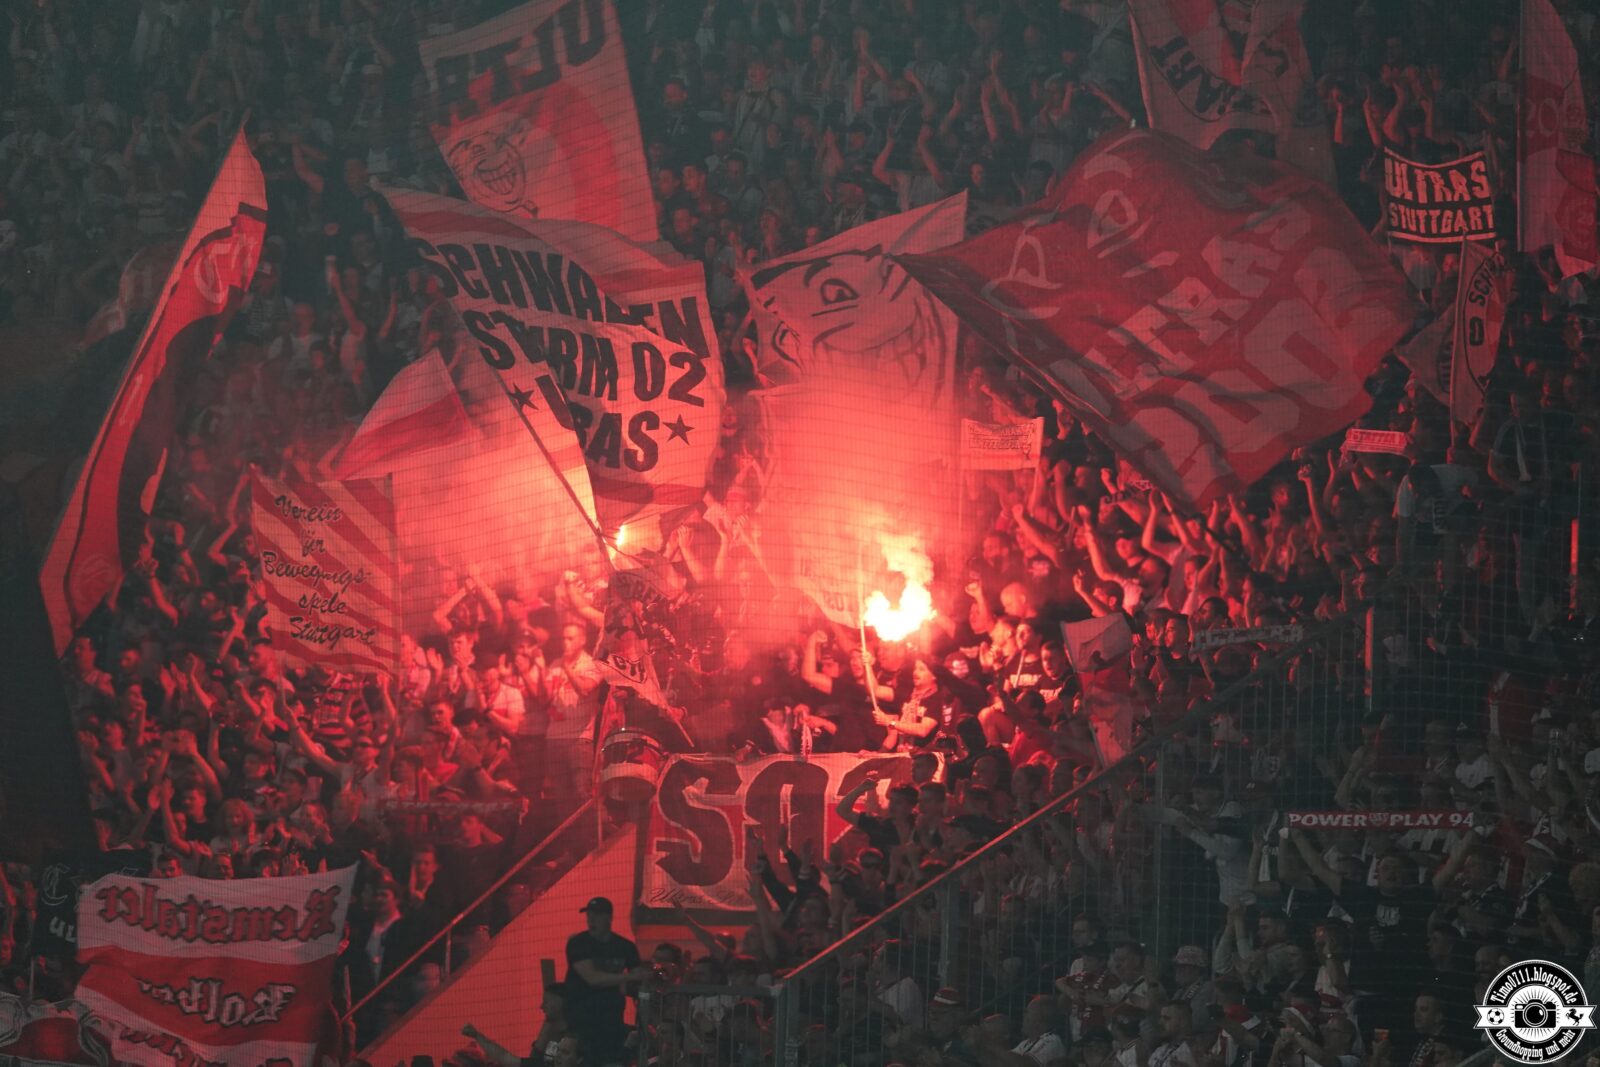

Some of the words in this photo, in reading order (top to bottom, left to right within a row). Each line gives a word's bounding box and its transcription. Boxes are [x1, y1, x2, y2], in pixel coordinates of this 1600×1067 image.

[1384, 158, 1490, 204] ULTRAS
[1389, 202, 1494, 234] STUTTGART
[409, 237, 711, 359] SCHWAN
[1288, 813, 1366, 827] POWER
[1389, 813, 1443, 827] PLAY
[1449, 812, 1475, 828] 94
